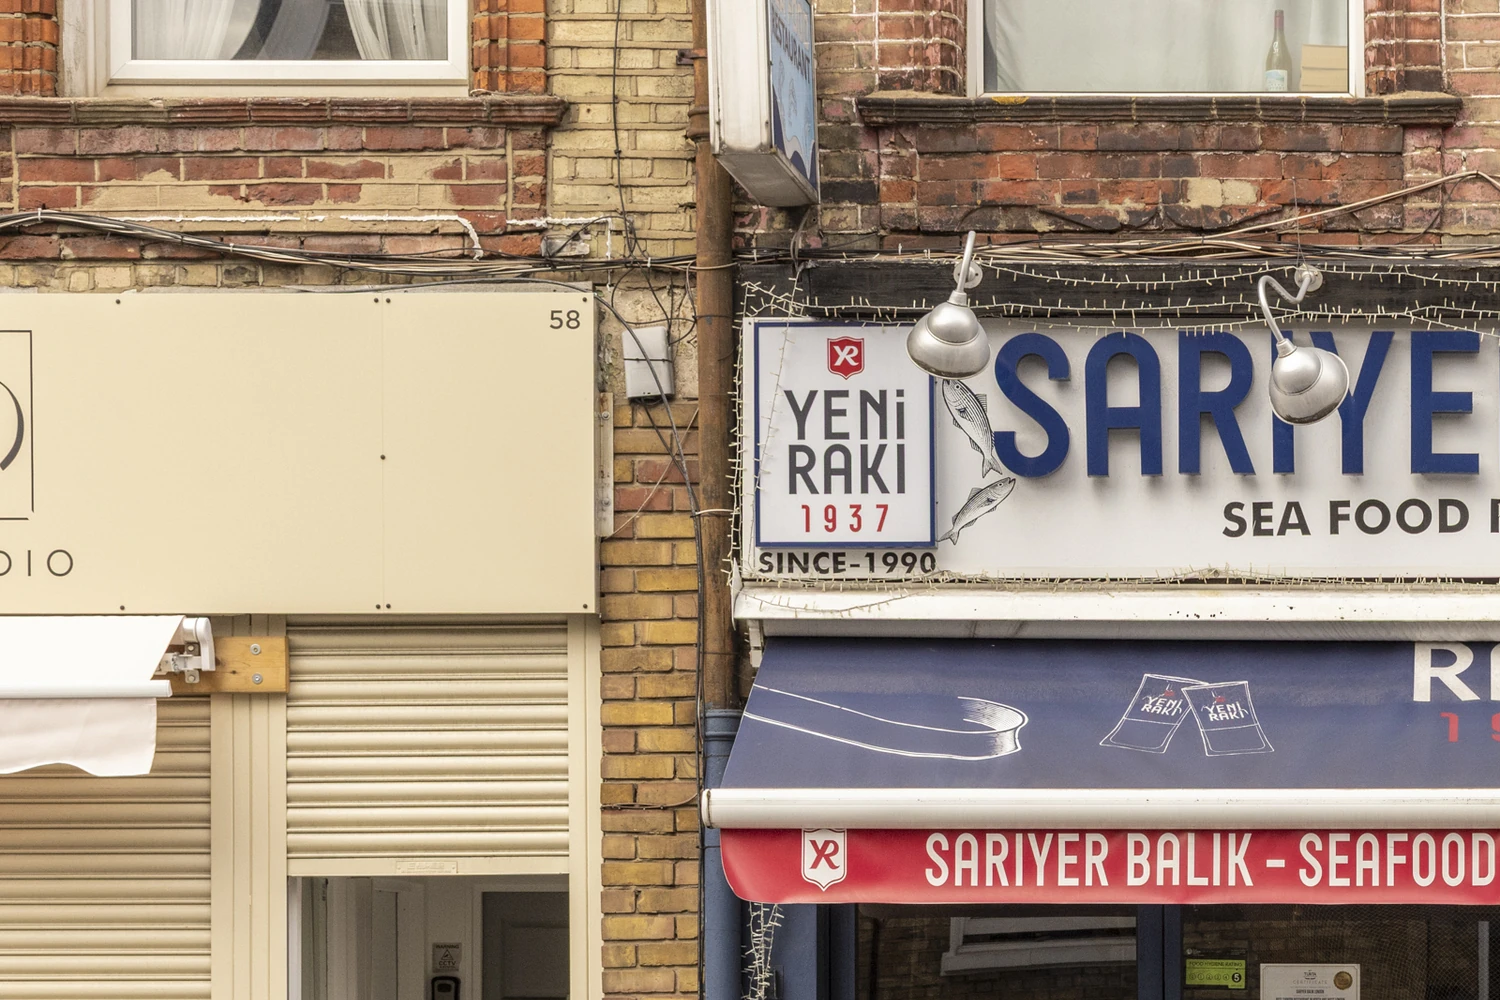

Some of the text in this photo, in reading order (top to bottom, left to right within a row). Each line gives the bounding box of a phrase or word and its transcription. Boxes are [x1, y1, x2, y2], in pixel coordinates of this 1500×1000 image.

[549, 310, 581, 330] 58
[788, 443, 905, 495] RAKI
[801, 504, 889, 533] 1937
[1223, 501, 1311, 538] SEA
[1329, 498, 1470, 536] FOOD
[758, 551, 937, 574] SINCE-1990
[1141, 703, 1178, 716] RAKI
[1209, 709, 1245, 721] RAKI
[924, 833, 1108, 888] SARIYER
[1127, 833, 1254, 888] BALIK
[1299, 832, 1497, 888] SEAFOOD
